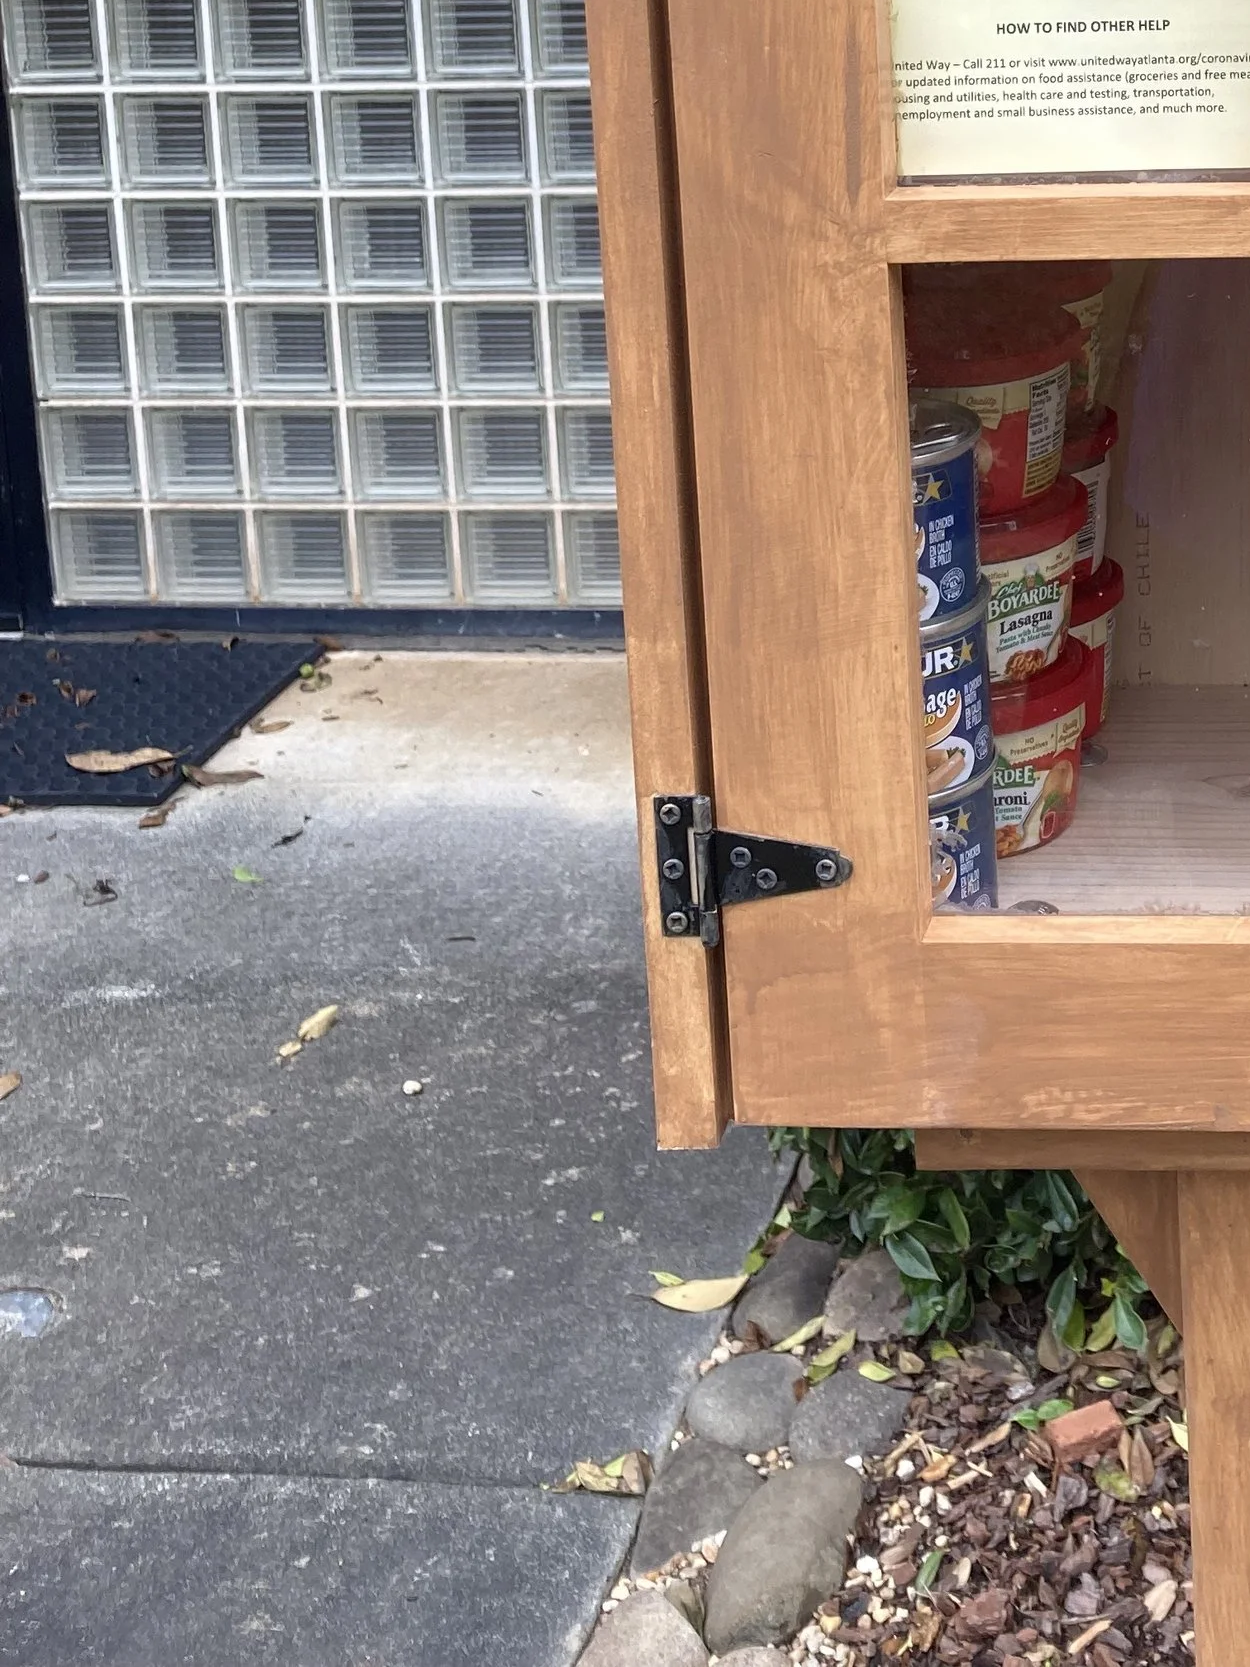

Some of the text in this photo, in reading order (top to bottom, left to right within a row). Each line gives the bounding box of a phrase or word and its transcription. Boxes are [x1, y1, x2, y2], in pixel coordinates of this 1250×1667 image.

[996, 19, 1170, 34] HOW TO FIND OTHER HELP
[925, 59, 951, 71] Way
[962, 58, 982, 69] Call
[986, 58, 1005, 68] 211
[1008, 60, 1020, 68] or
[1023, 57, 1045, 67] visit
[973, 102, 1226, 118] and small business assistance, and much more.
[997, 582, 1023, 599] Chef
[988, 581, 1060, 621] BOYARDEE
[1000, 608, 1053, 636] Lasagna
[996, 641, 1019, 654] Tomato
[1027, 634, 1041, 643] Meat
[1000, 635, 1017, 645] Pasta
[1018, 630, 1032, 639] with
[1010, 741, 1048, 755] Preservatives
